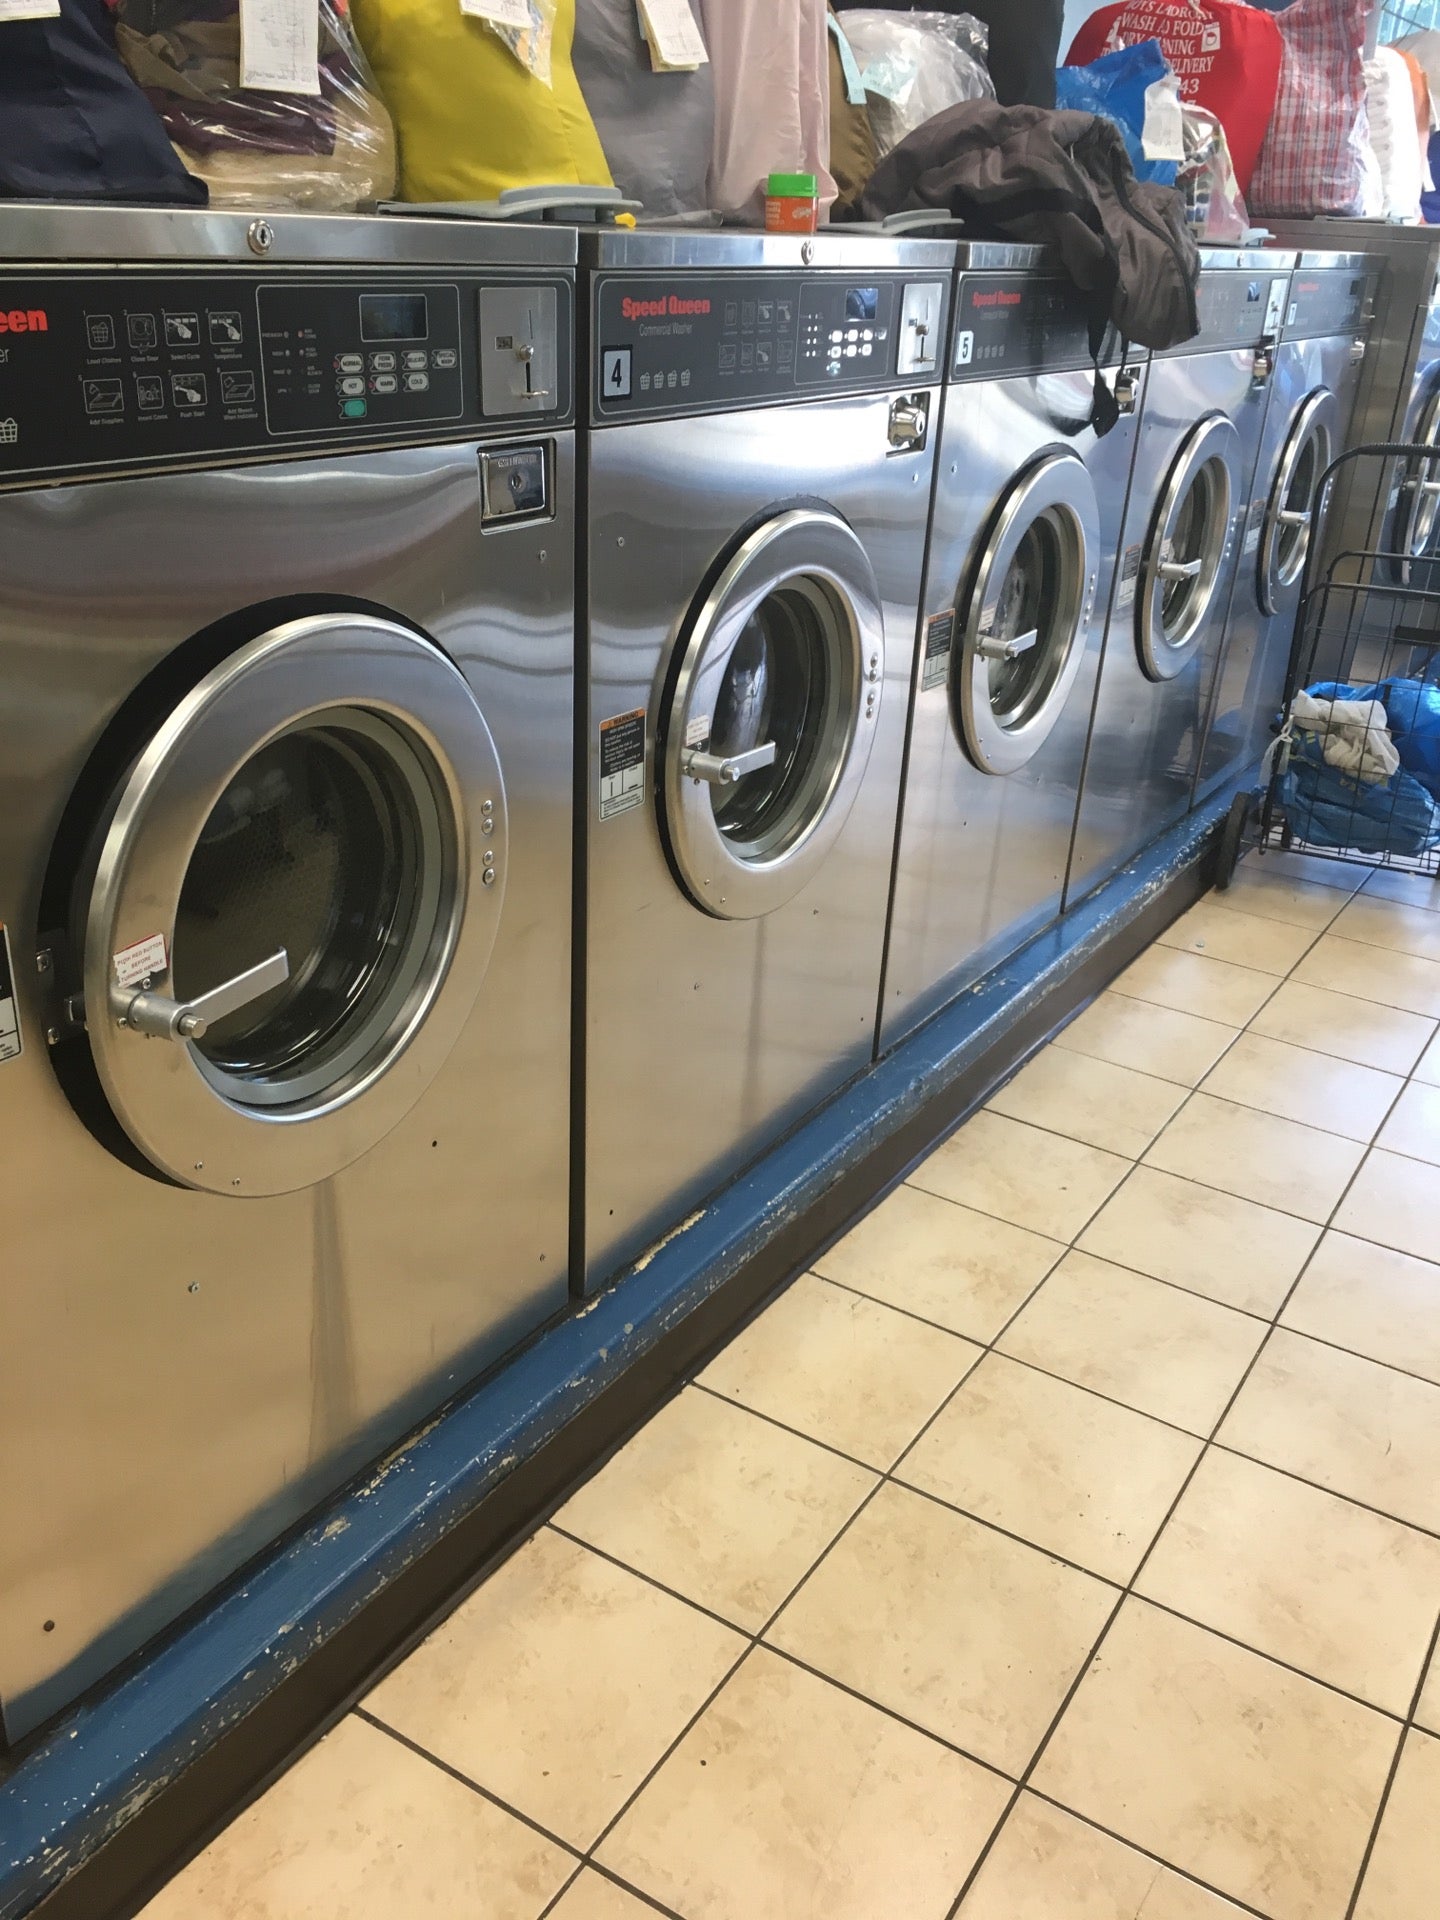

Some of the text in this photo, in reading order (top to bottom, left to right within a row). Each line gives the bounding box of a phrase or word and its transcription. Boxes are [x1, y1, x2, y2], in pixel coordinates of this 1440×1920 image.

[1120, 12, 1157, 32] WASH
[1172, 20, 1204, 37] FOLD
[622, 294, 711, 321] Speed Queen
[962, 336, 970, 359] 5
[611, 358, 623, 388] 4
